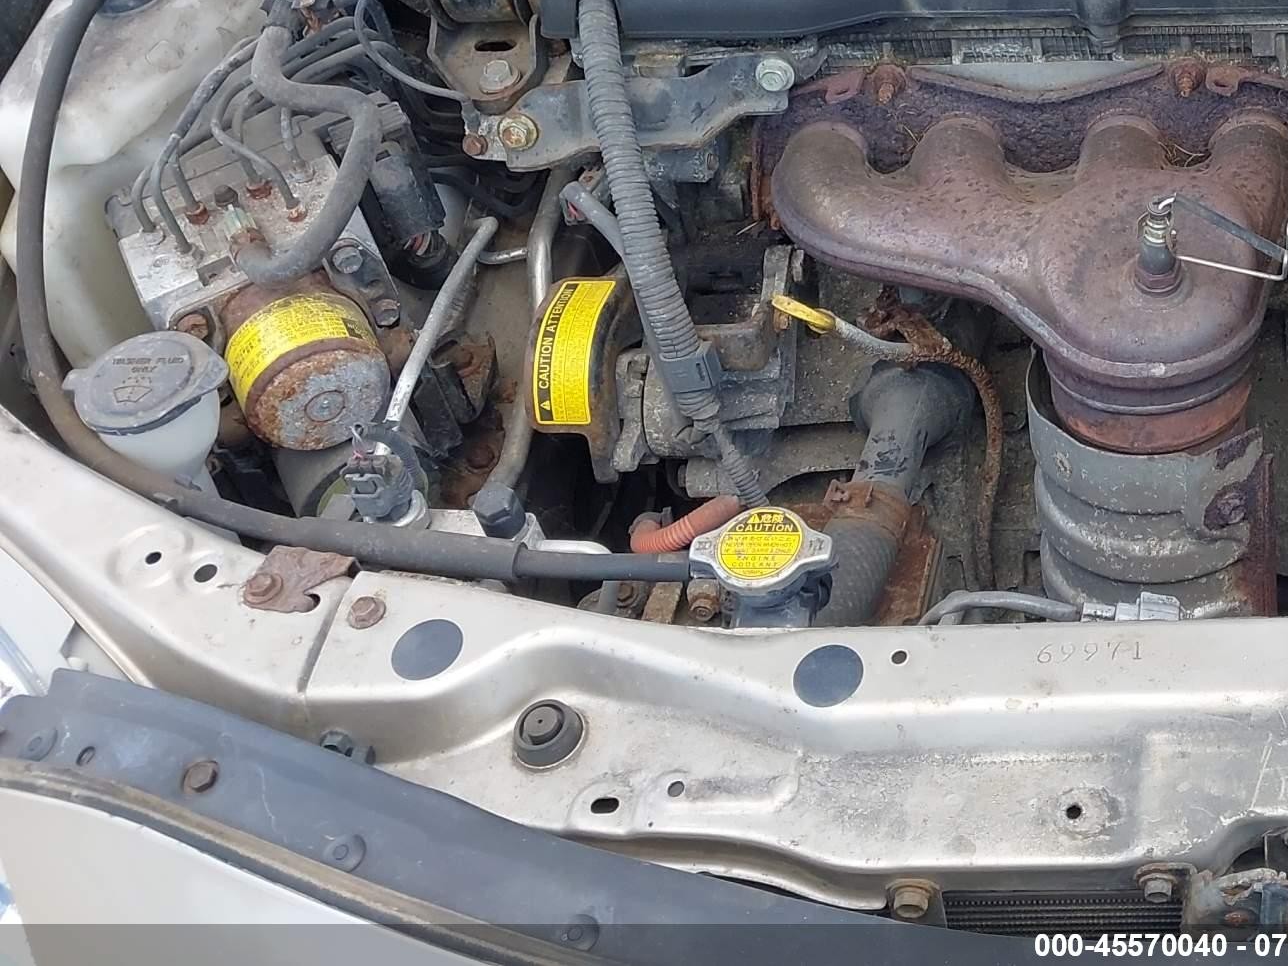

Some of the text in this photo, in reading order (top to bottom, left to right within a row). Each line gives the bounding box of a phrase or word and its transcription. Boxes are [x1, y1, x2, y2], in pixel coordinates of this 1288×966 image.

[538, 288, 575, 390] CAUTION ATTENTION
[735, 523, 794, 532] CAUTION
